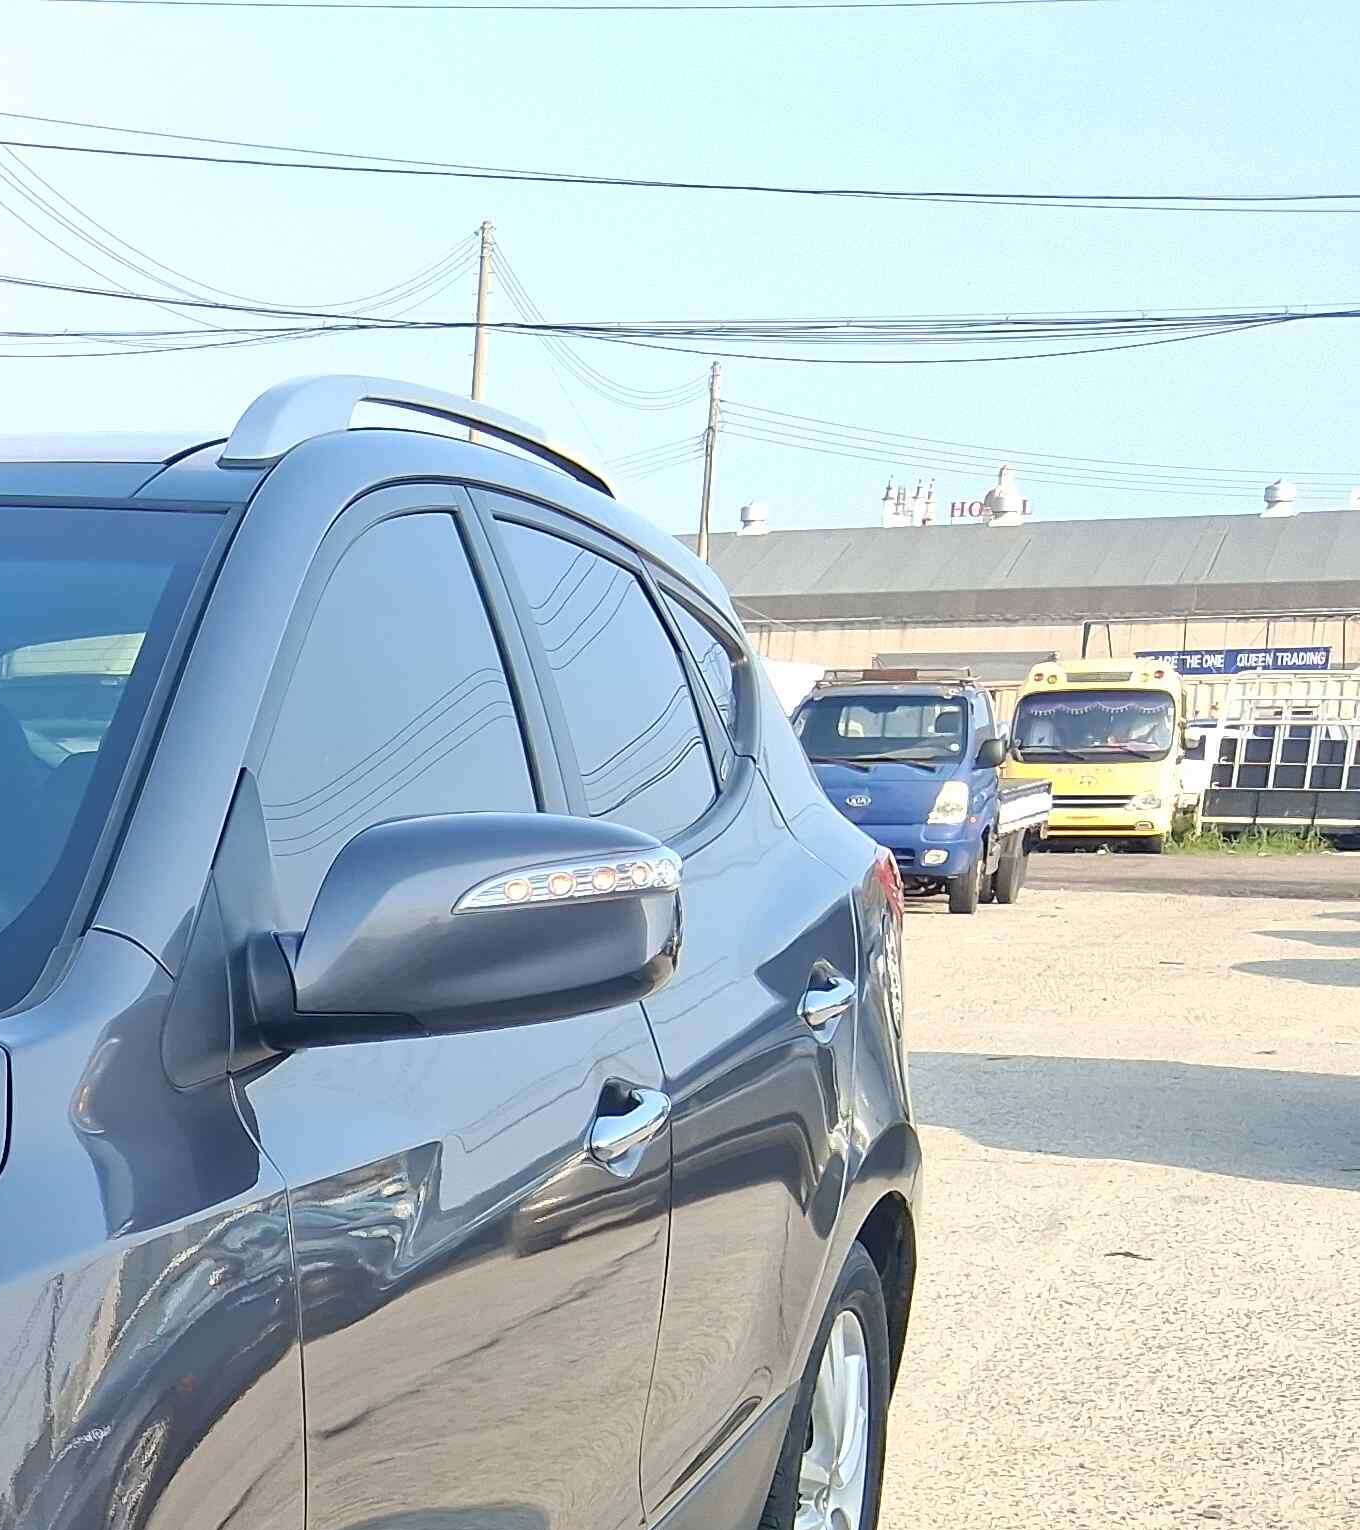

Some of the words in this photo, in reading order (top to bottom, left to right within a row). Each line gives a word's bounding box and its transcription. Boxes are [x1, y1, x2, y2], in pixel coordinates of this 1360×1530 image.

[950, 499, 1033, 518] HOL
[1202, 654, 1225, 668] ONE
[1236, 653, 1273, 667] QUEEN
[1276, 652, 1326, 666] TRADING
